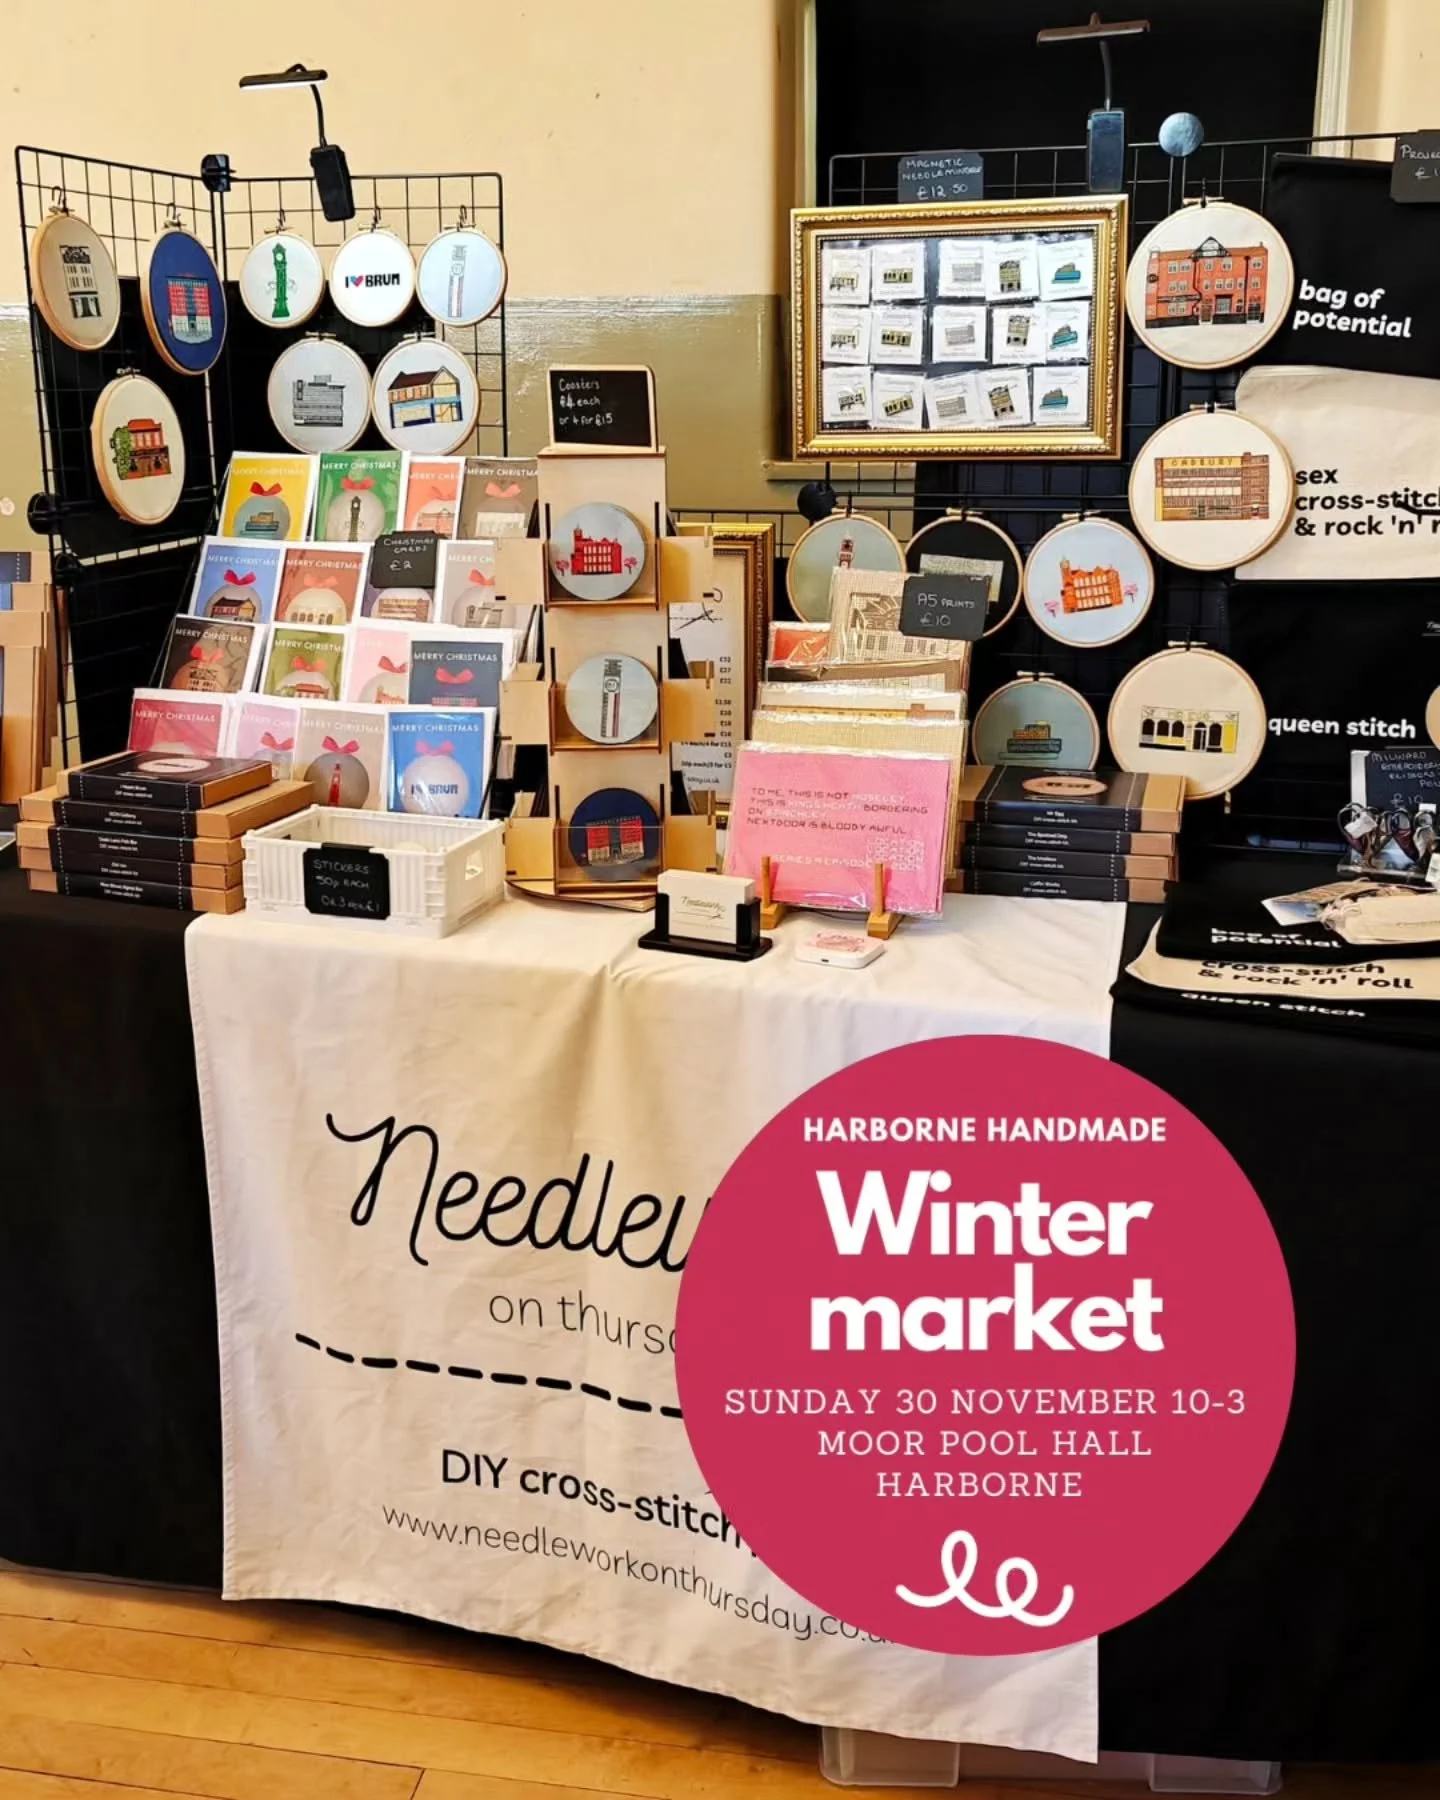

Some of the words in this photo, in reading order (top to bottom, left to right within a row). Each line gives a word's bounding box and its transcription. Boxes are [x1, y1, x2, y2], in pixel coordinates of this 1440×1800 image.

[906, 157, 964, 169] MAGNETIC
[365, 273, 400, 288] BRUM
[1299, 279, 1349, 309] bag
[1353, 288, 1385, 309] of
[1293, 308, 1412, 338] potential
[559, 378, 600, 392] Coasters
[577, 396, 601, 407] each
[595, 413, 613, 426] £15
[467, 467, 494, 476] MERRY
[496, 467, 538, 477] CHRISTMA
[1295, 468, 1338, 485] sex
[1295, 486, 1440, 511] cross-stitc
[1295, 516, 1316, 536] &
[1325, 515, 1384, 536] rock
[287, 559, 313, 567] MERRY
[918, 592, 938, 608] A5
[941, 597, 975, 609] PRINTS
[920, 611, 951, 626] £10
[176, 629, 201, 638] MERRY
[203, 631, 248, 643] CHRISTMAS
[275, 639, 301, 648] MERRY
[304, 641, 344, 652] CHRISTM
[414, 651, 443, 660] MERRY
[446, 652, 498, 662] CHRISTMAS
[135, 709, 163, 719] MERRY
[166, 712, 215, 722] CHRISTMAS
[392, 724, 423, 732] MERRY
[425, 724, 479, 732] CHRISTMAS
[1268, 717, 1340, 736] queen
[1346, 717, 1417, 738] stitch
[789, 789, 812, 798] THIS
[826, 792, 848, 800] NOT
[748, 807, 762, 815] ON
[863, 804, 928, 814] BORDERING
[820, 821, 866, 831] BLOODY
[312, 859, 369, 875] STICKERS
[343, 878, 369, 889] EACH
[1211, 935, 1342, 949] potential
[1201, 959, 1385, 977] cross-stitch
[1198, 968, 1223, 979] &
[1232, 973, 1301, 986] rock
[1357, 976, 1414, 989] roll
[1181, 992, 1271, 1008] queen
[1278, 1003, 1366, 1018] stitch
[489, 1295, 543, 1328] on
[442, 1449, 508, 1489] DIY
[519, 1466, 740, 1549] cross-stitch
[382, 1503, 895, 1645] www.needleworkonthursday.co.
